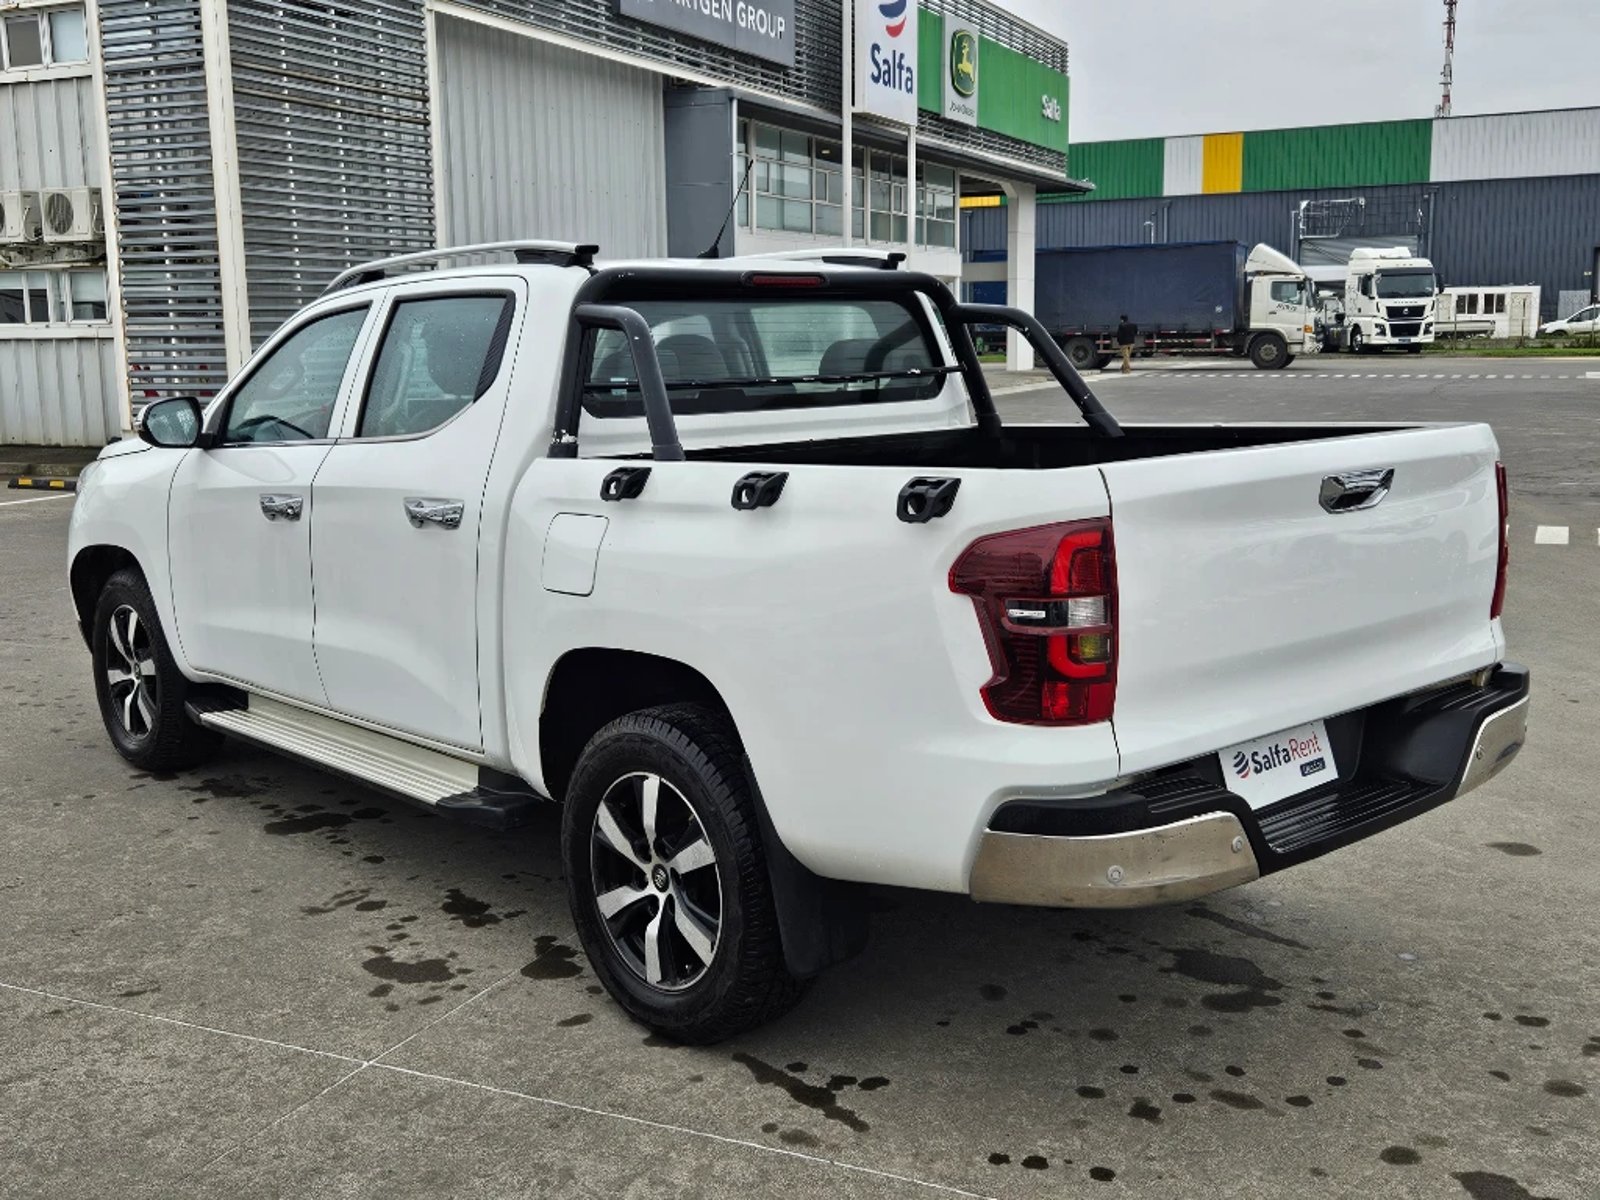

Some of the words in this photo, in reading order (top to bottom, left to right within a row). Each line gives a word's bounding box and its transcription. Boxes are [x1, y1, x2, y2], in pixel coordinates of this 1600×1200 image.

[736, 1, 785, 39] GROUP
[870, 43, 914, 94] Salfa
[1251, 731, 1323, 775] SalfaRent
